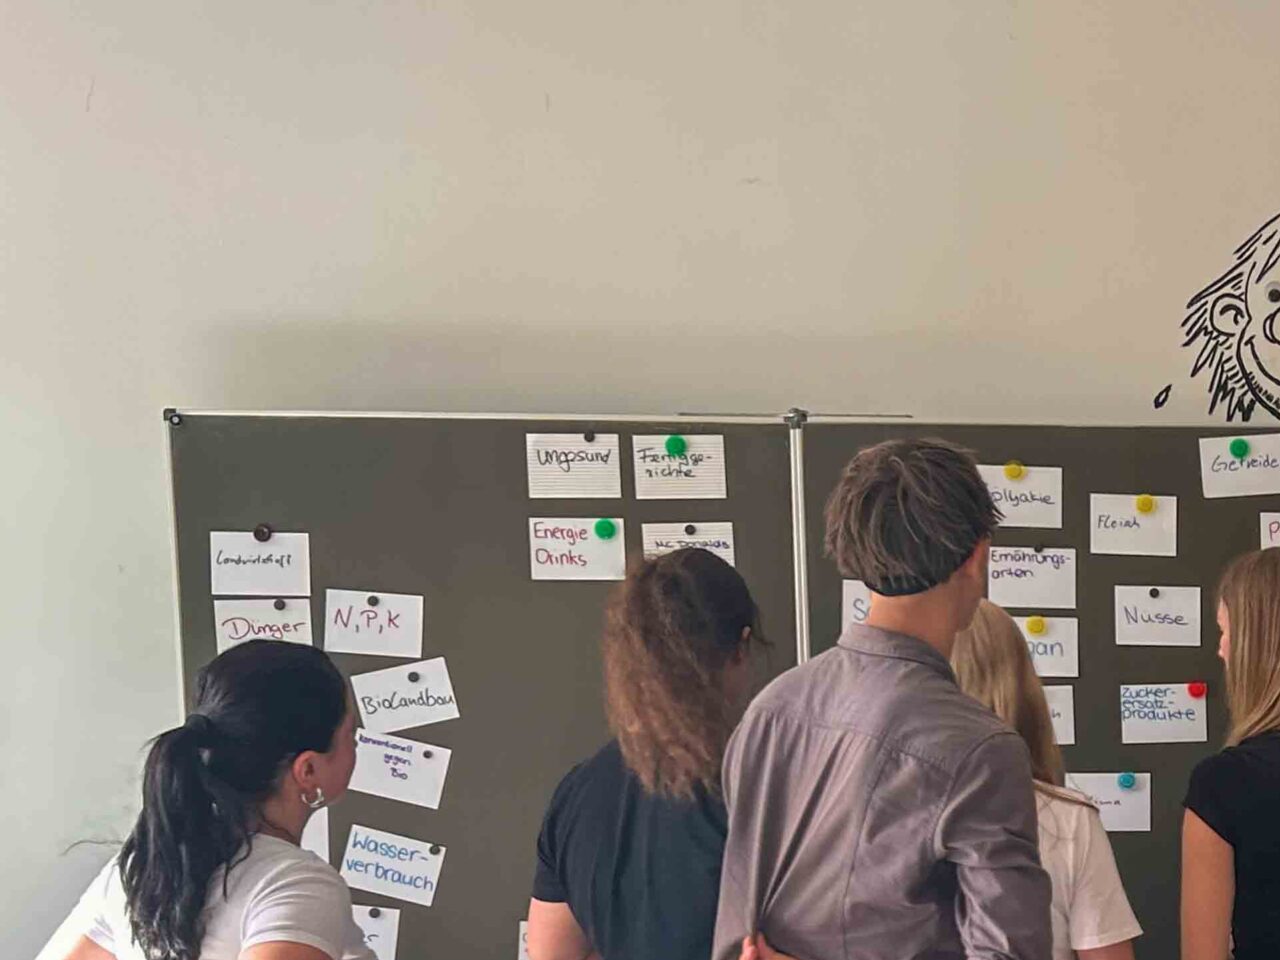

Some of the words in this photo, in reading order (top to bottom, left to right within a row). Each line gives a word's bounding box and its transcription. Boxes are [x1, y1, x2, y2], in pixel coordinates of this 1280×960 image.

[533, 521, 588, 545] Energie
[535, 547, 588, 567] Drinks
[221, 617, 307, 640] Dünger
[352, 832, 429, 863] Wasser-
[345, 858, 435, 892] verbrauch
